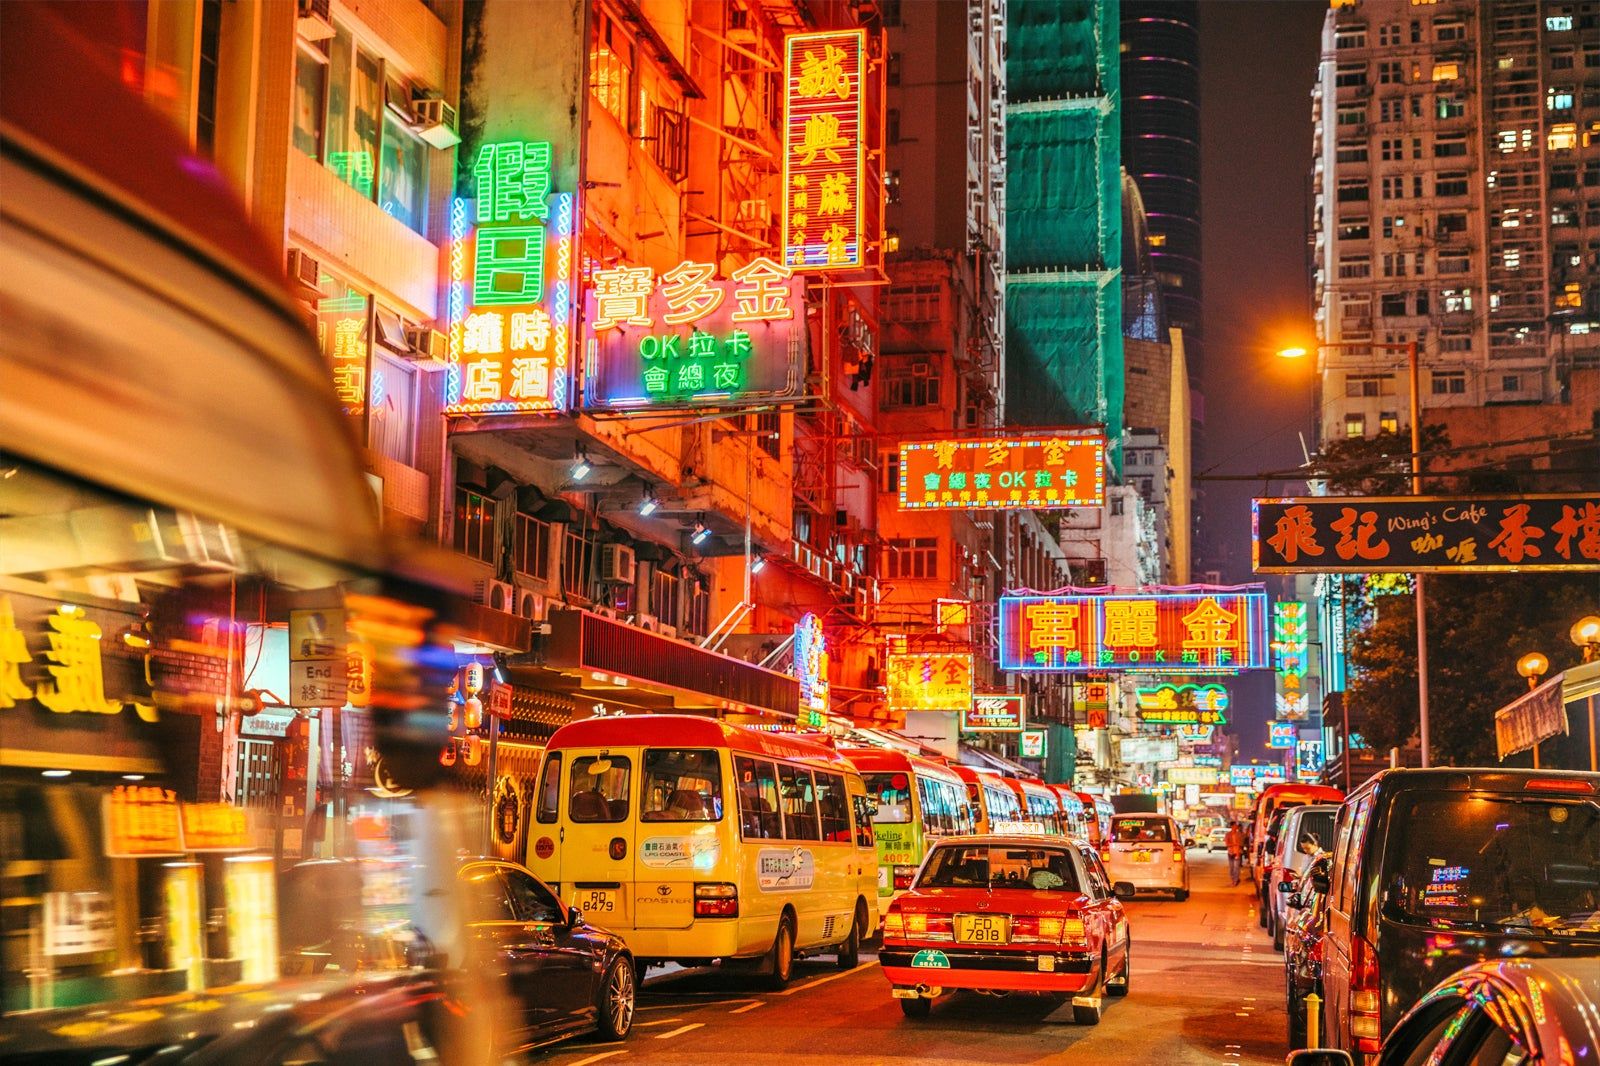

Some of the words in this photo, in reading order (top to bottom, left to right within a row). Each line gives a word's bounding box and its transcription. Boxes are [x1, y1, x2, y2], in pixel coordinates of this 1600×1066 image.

[473, 140, 553, 307] 假日
[1387, 512, 1437, 534] Wing's
[1442, 505, 1489, 526] Cafe
[1266, 505, 1390, 564] 飛記
[306, 666, 333, 679] End
[999, 823, 1040, 834] TAXI
[883, 853, 911, 863] 4002
[590, 891, 607, 902] RD
[637, 897, 693, 905] COASTER
[583, 901, 614, 912] 8479
[974, 918, 992, 930] FD
[966, 929, 1000, 941] 7818
[926, 954, 935, 962] 4
